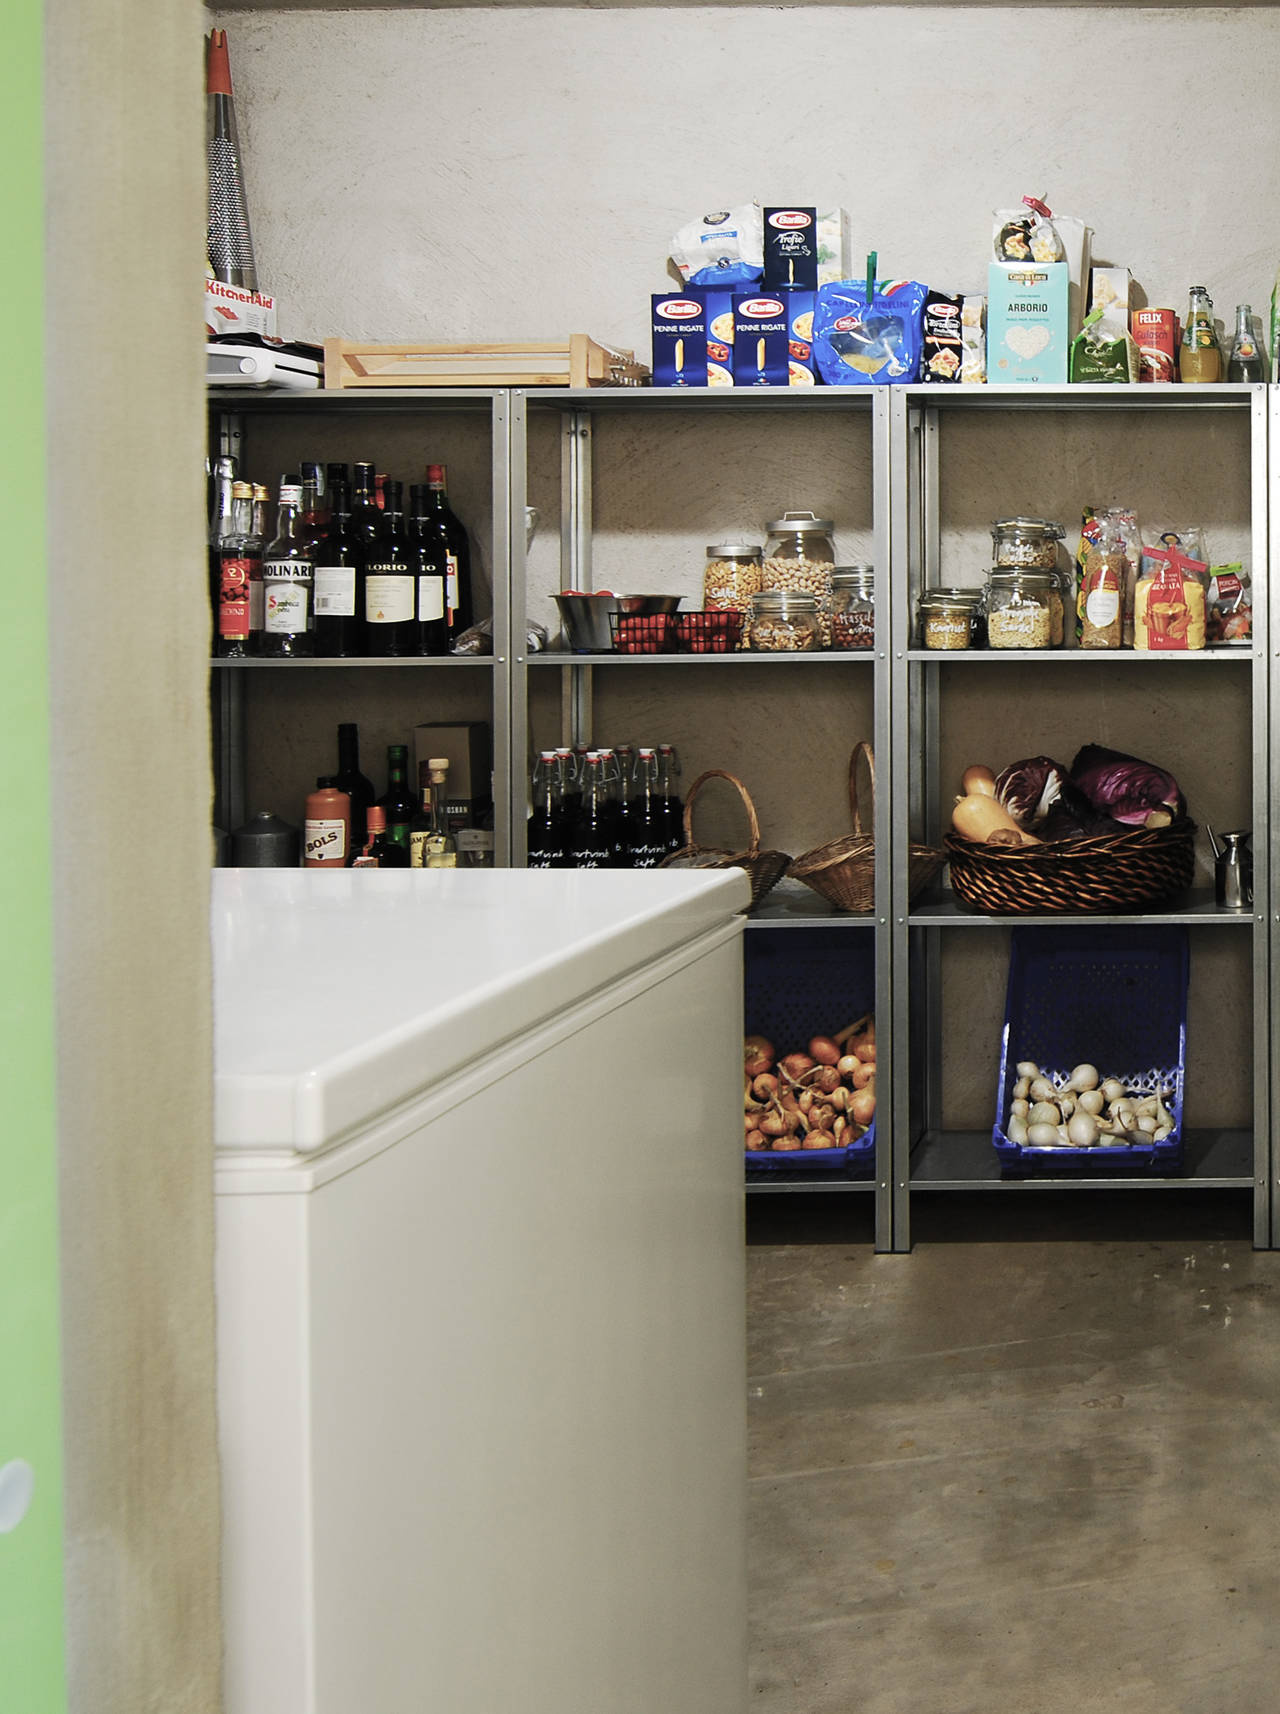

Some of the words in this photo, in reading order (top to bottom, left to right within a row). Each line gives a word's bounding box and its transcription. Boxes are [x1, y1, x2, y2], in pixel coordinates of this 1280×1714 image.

[781, 214, 809, 225] Barilla
[666, 303, 698, 315] Barilla
[748, 302, 780, 314] Barilla
[1008, 303, 1048, 313] ARBORIO
[1139, 313, 1162, 323] FELIX
[679, 324, 704, 332] RIGATE
[736, 324, 760, 332] PENNE
[929, 622, 966, 633] Kamut
[307, 832, 338, 852] BOLS
